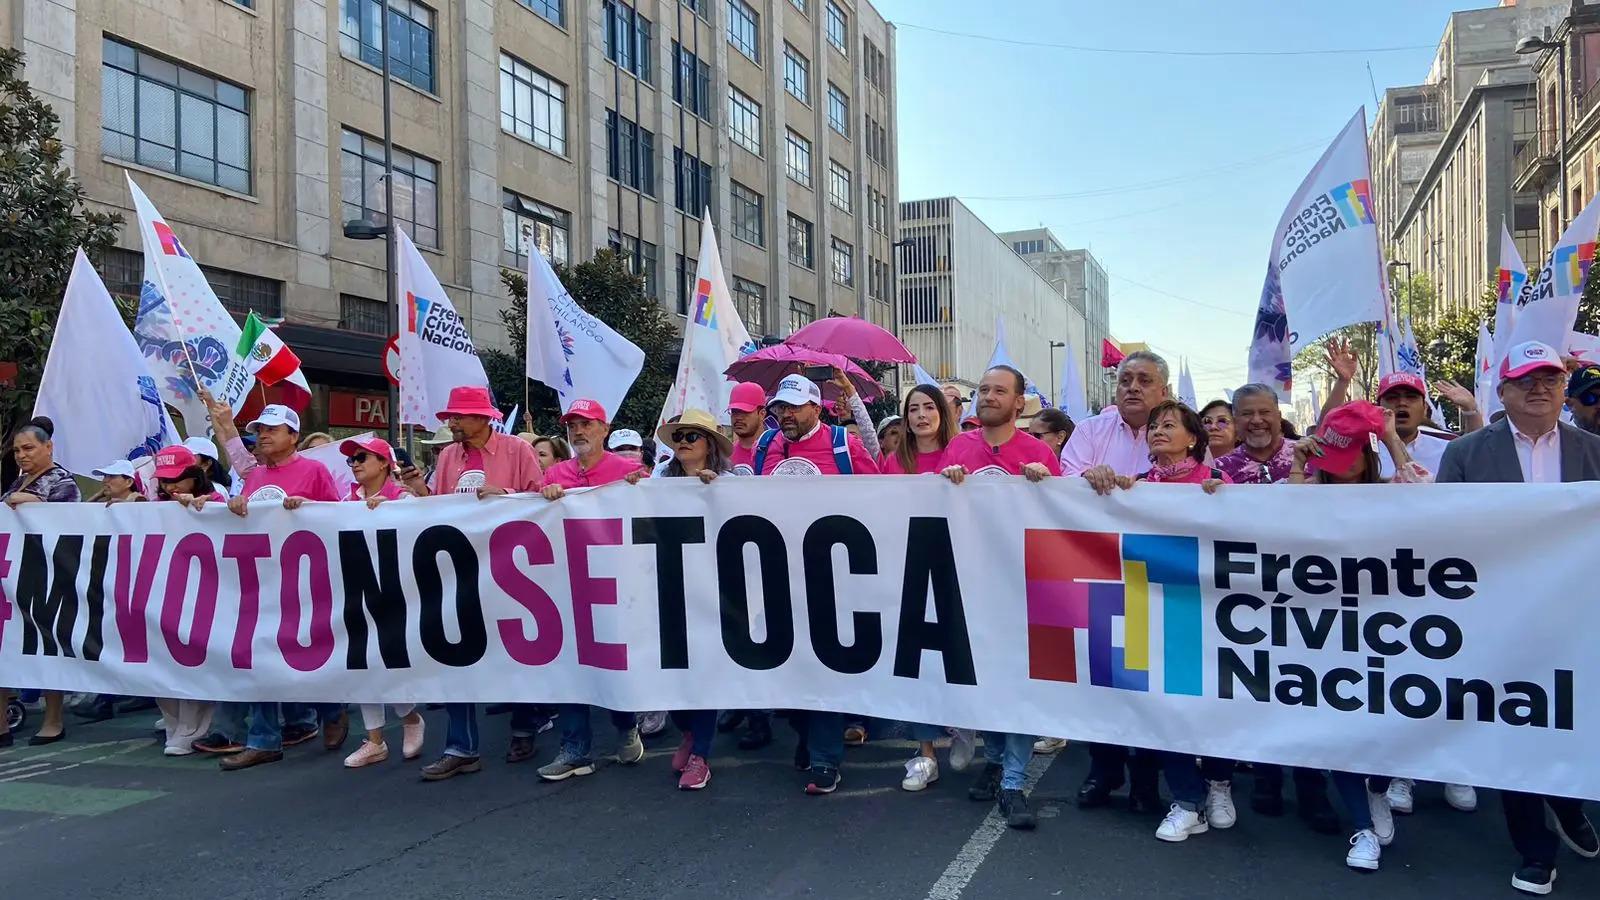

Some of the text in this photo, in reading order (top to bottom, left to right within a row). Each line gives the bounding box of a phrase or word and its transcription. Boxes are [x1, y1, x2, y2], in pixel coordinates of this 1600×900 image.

[1213, 540, 1478, 600] Frente
[1215, 592, 1464, 660] Cívico
[1217, 646, 1574, 731] Nacional
